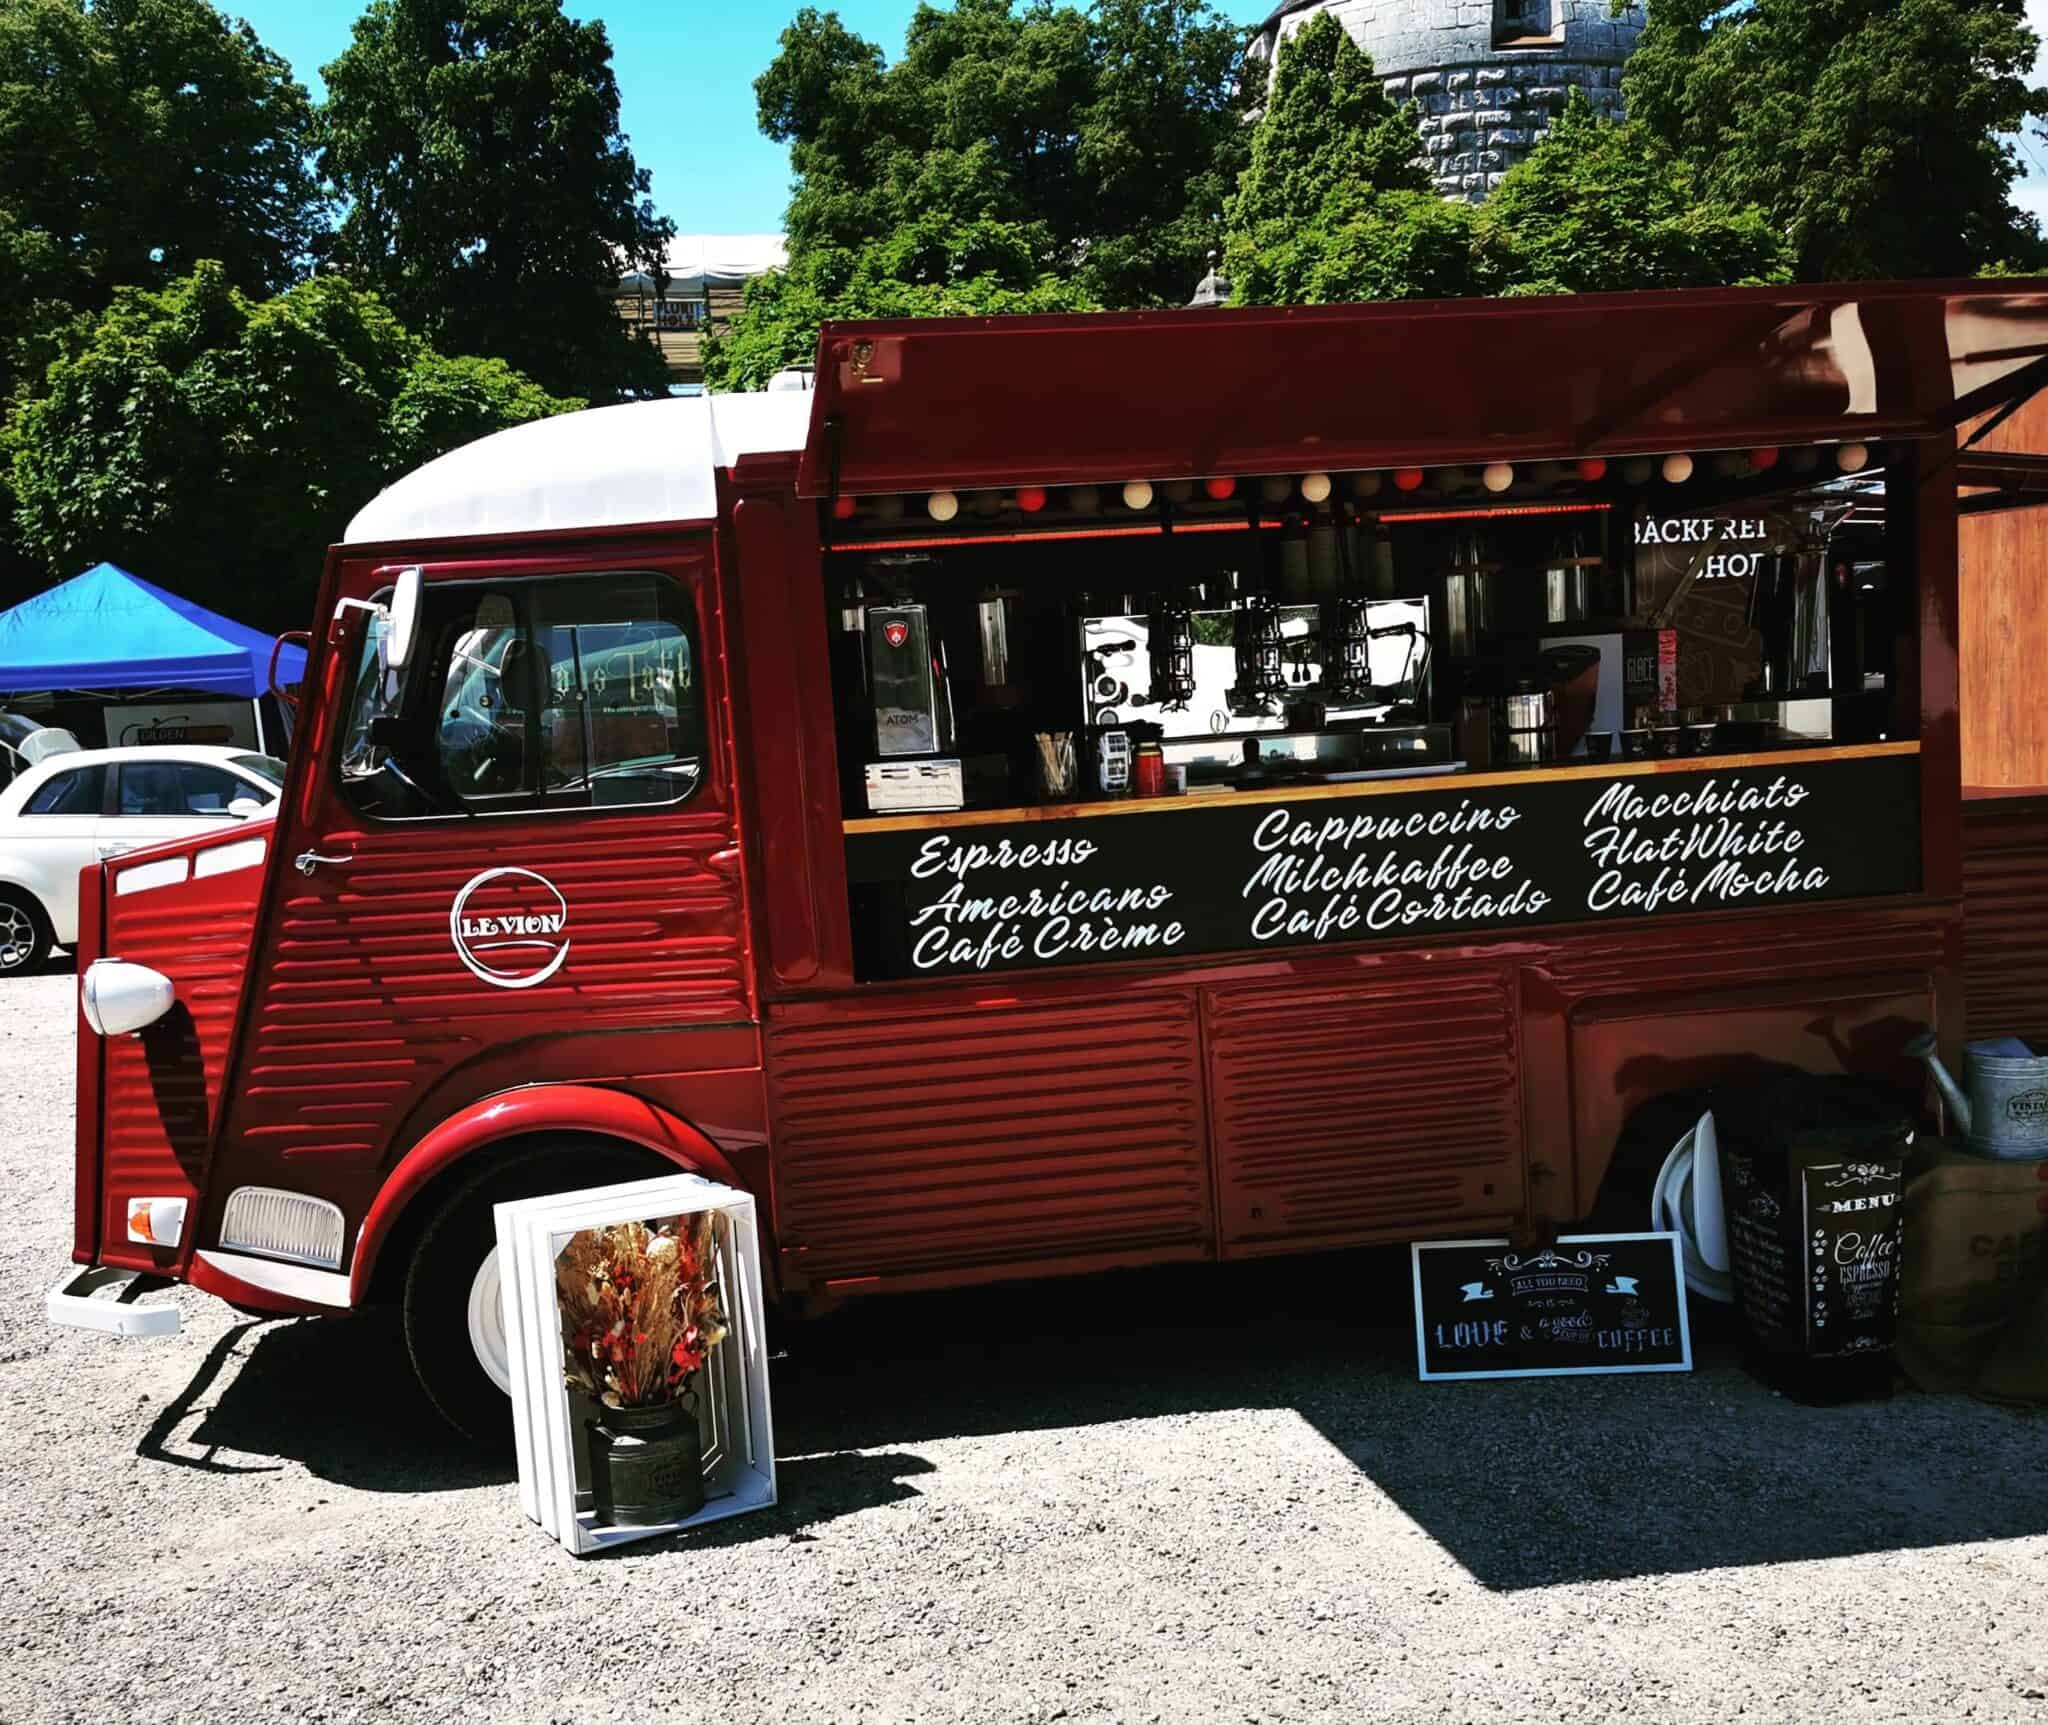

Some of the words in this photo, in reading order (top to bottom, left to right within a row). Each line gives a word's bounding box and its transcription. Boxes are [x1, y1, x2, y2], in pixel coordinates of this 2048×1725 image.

[886, 713, 919, 727] ATOM
[1583, 775, 1810, 827] Macchiato
[1253, 799, 1522, 852] Cappuccino
[1681, 816, 1805, 861] White
[910, 835, 1099, 879] Espresso
[1242, 843, 1514, 899] Milchkaffee
[909, 880, 1173, 926] Americano
[1587, 866, 1689, 912] Café
[1690, 857, 1830, 904] Mocha
[461, 917, 498, 938] LE
[497, 913, 561, 935] VION
[1251, 893, 1361, 940] Café
[1366, 879, 1552, 930] Cortado
[912, 922, 1025, 969] Café
[1033, 915, 1186, 959] Crème
[1831, 1193, 1896, 1214] MENU
[1834, 1232, 1895, 1268] Coffee
[1839, 1261, 1890, 1284] ESPRESSO
[1434, 1319, 1511, 1350] LOVE
[1518, 1324, 1536, 1341] &
[1551, 1308, 1593, 1335] good
[1597, 1326, 1675, 1353] COFFEE
